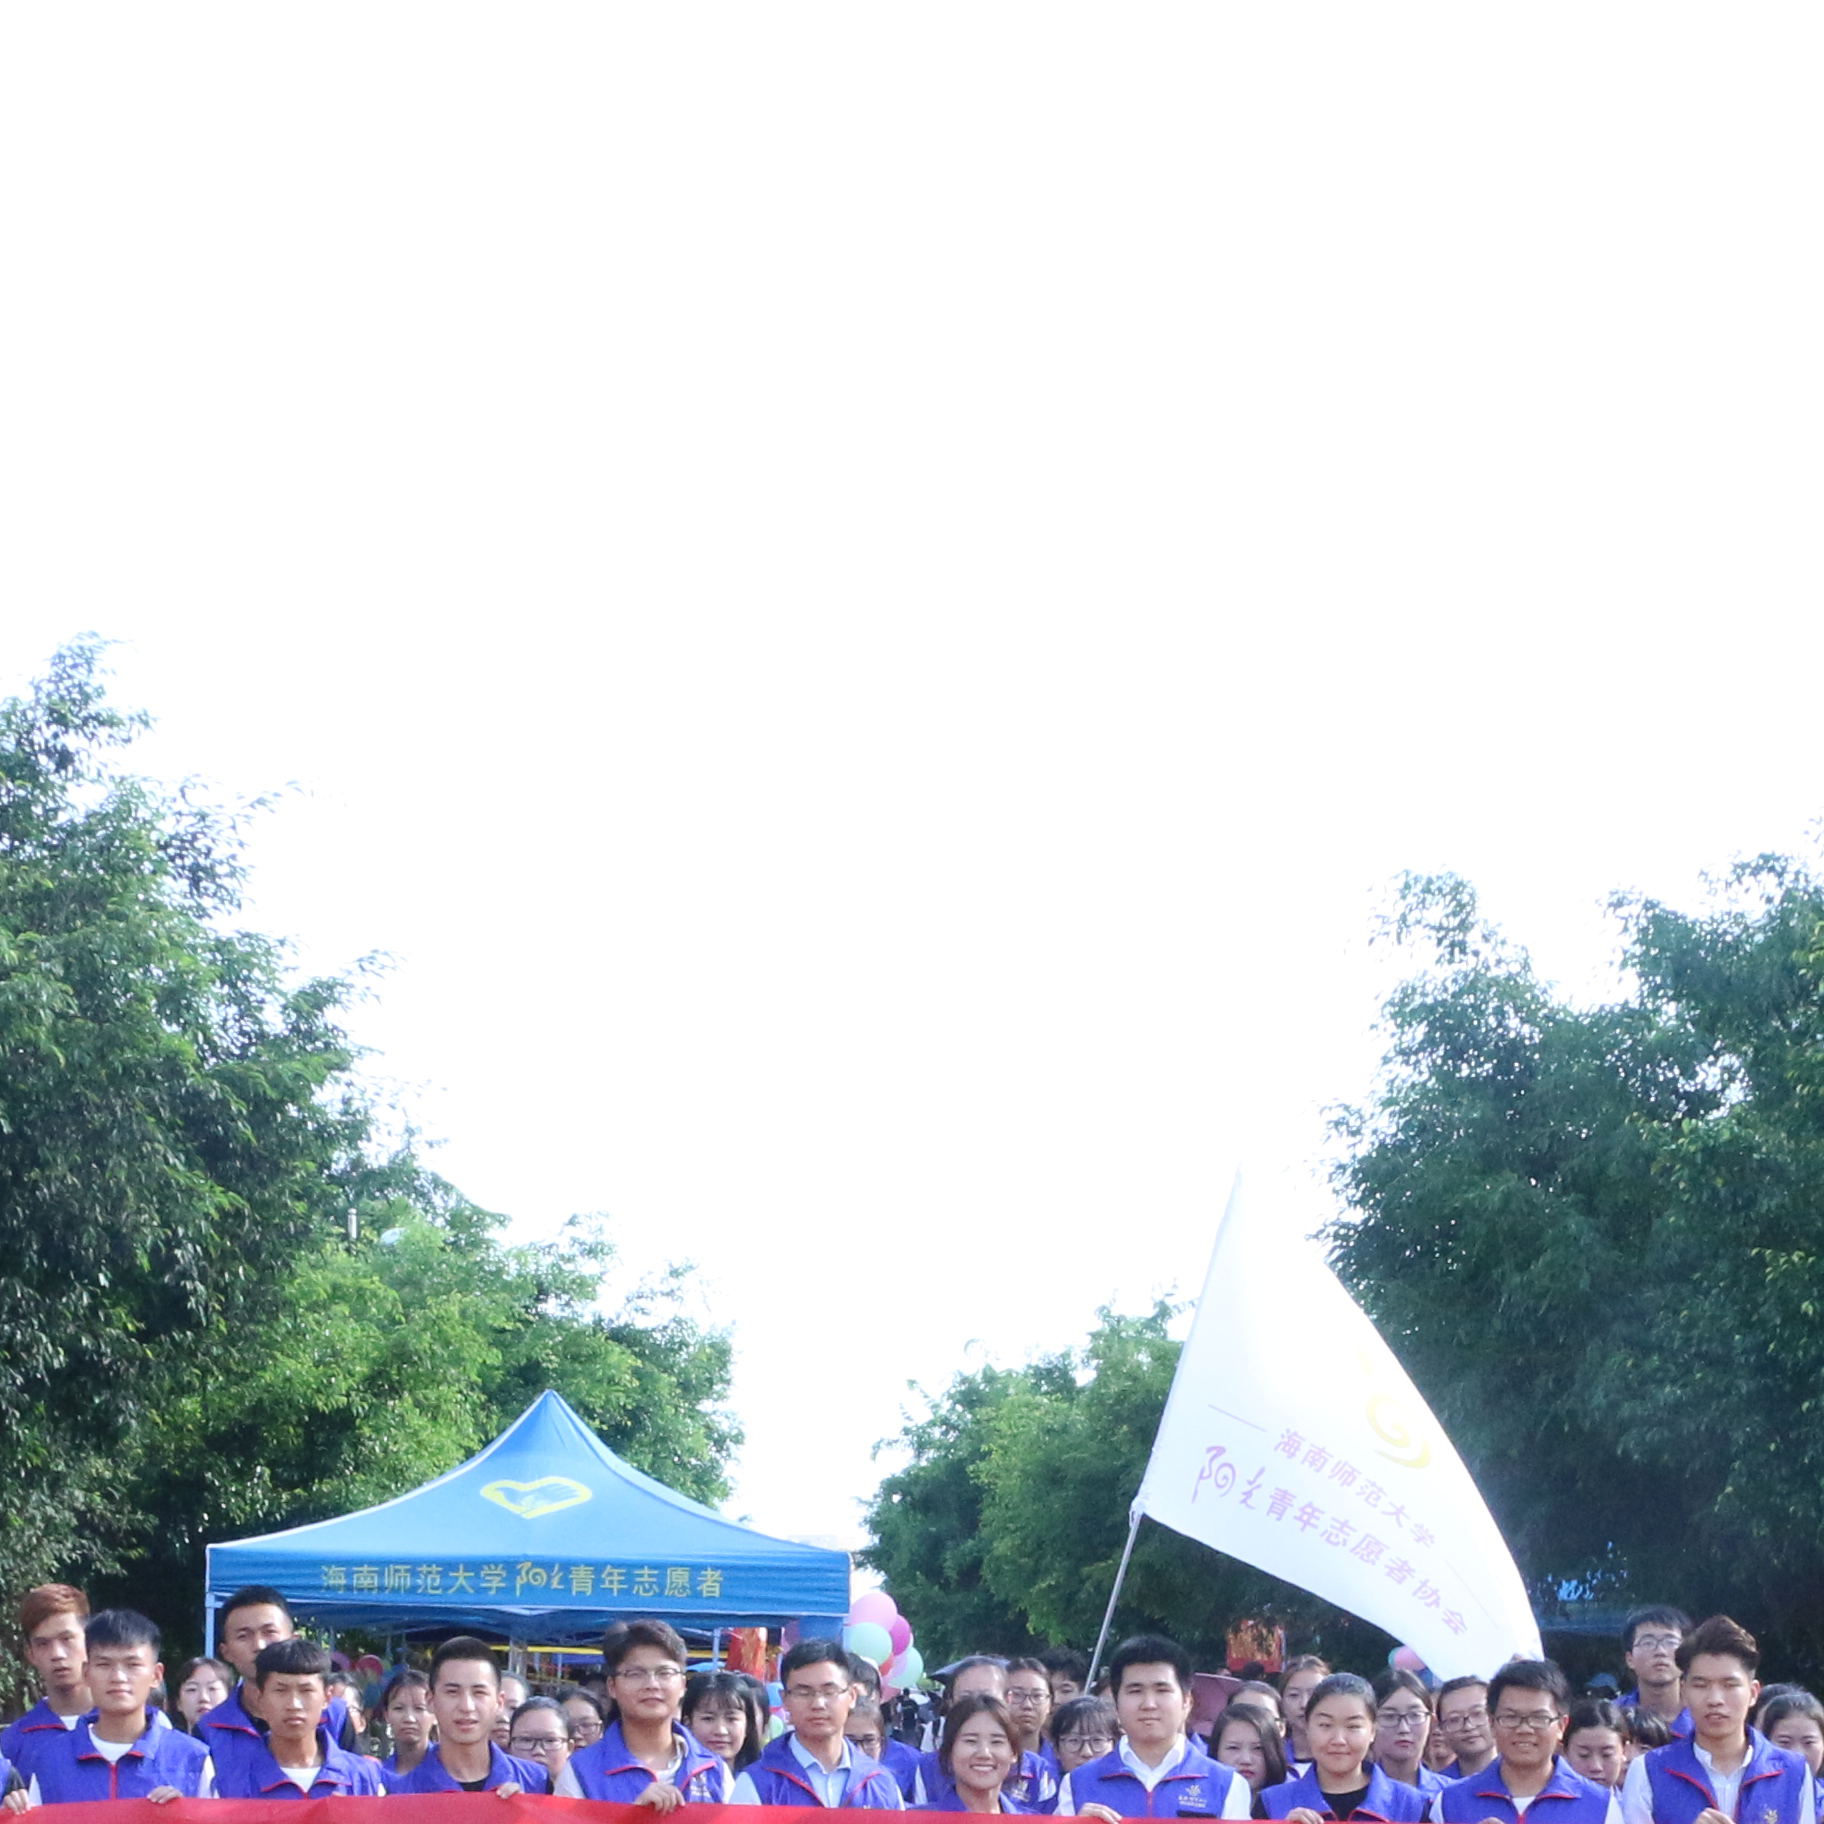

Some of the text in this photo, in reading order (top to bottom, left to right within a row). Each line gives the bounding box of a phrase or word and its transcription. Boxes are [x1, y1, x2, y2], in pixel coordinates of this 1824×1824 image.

[1191, 1445, 1471, 1637] 阳光青年志愿者协会
[1274, 1428, 1437, 1549] 海南师范大学
